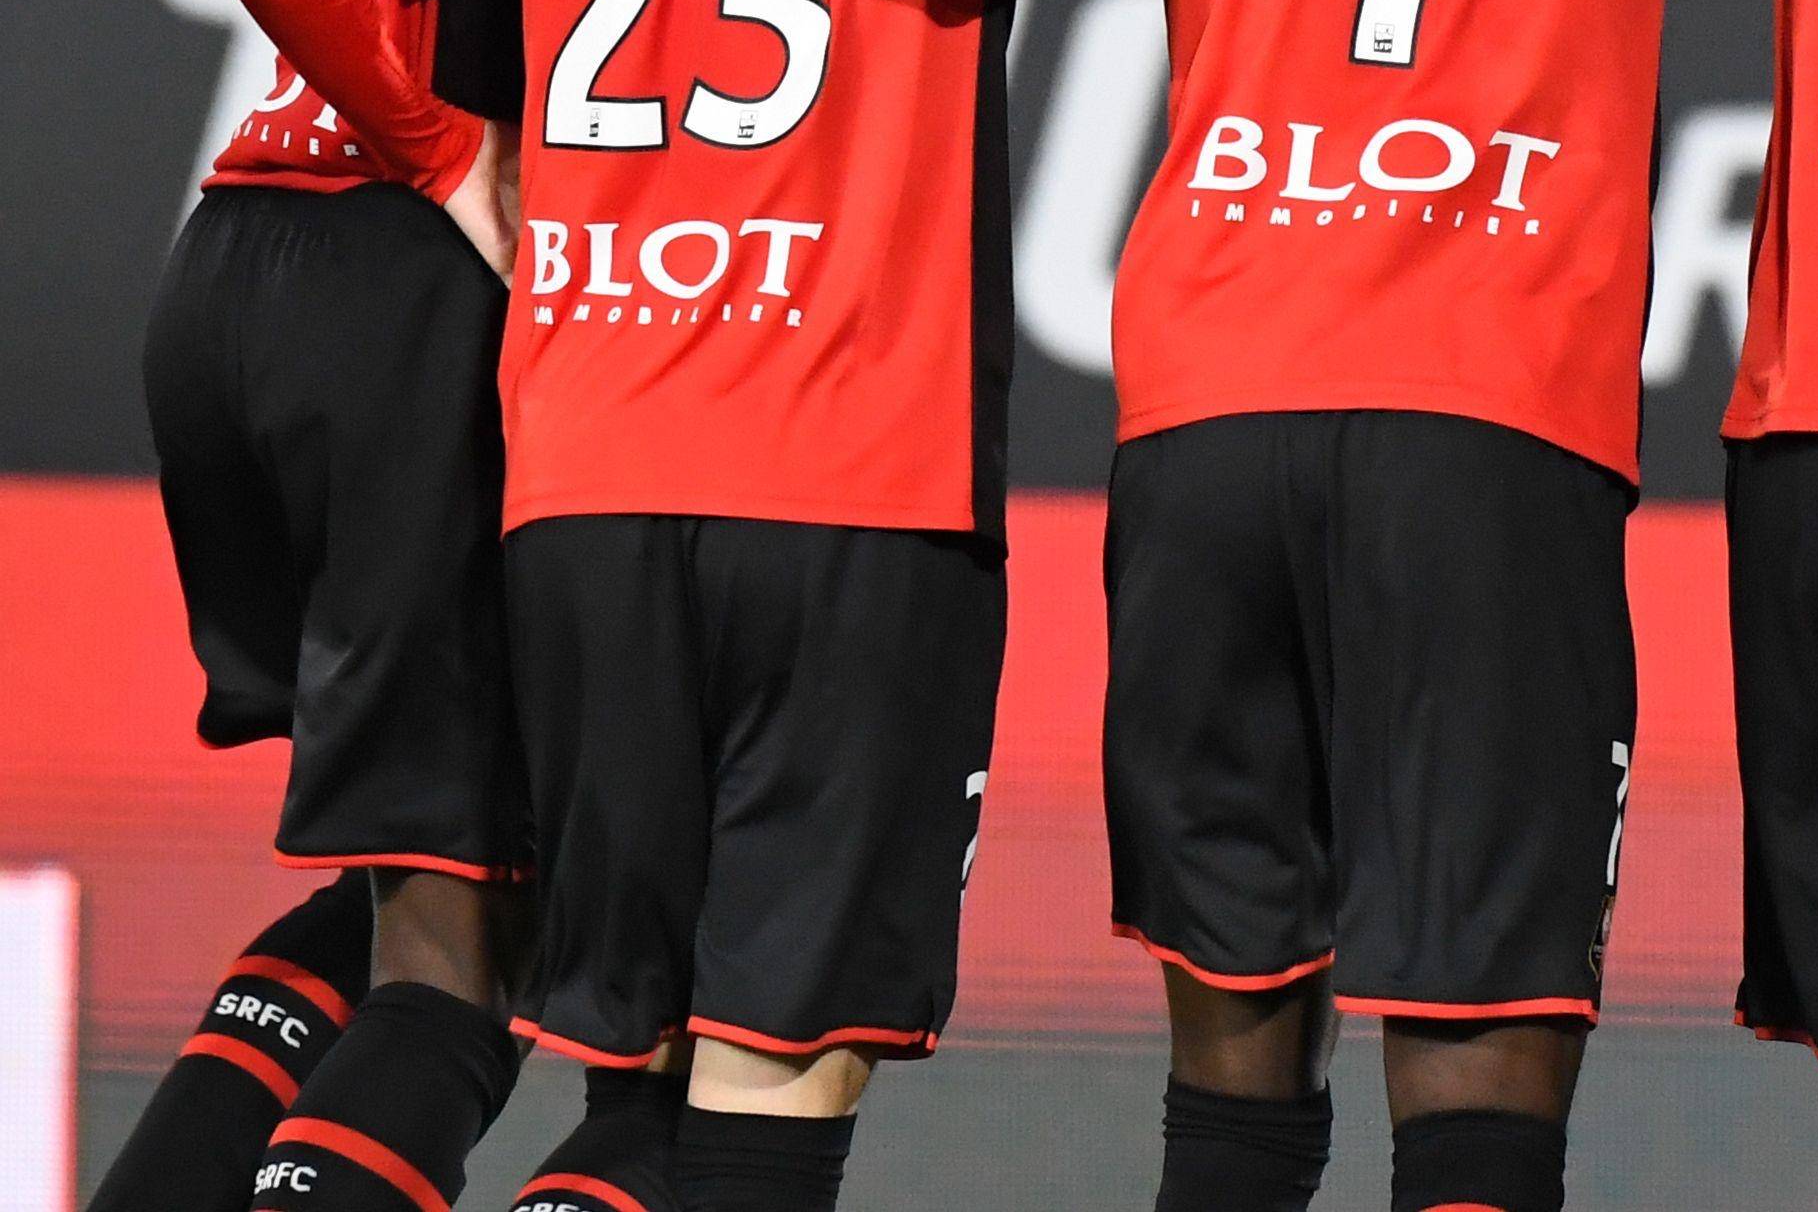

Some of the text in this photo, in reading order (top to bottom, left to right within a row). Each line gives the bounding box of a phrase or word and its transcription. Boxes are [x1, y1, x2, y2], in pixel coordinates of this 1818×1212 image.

[1187, 115, 1562, 212] BLOT
[1190, 198, 1541, 235] IMMOBILIER
[527, 218, 825, 301] BLOT
[214, 991, 310, 1049] SRFC
[254, 1161, 318, 1195] SRFC
